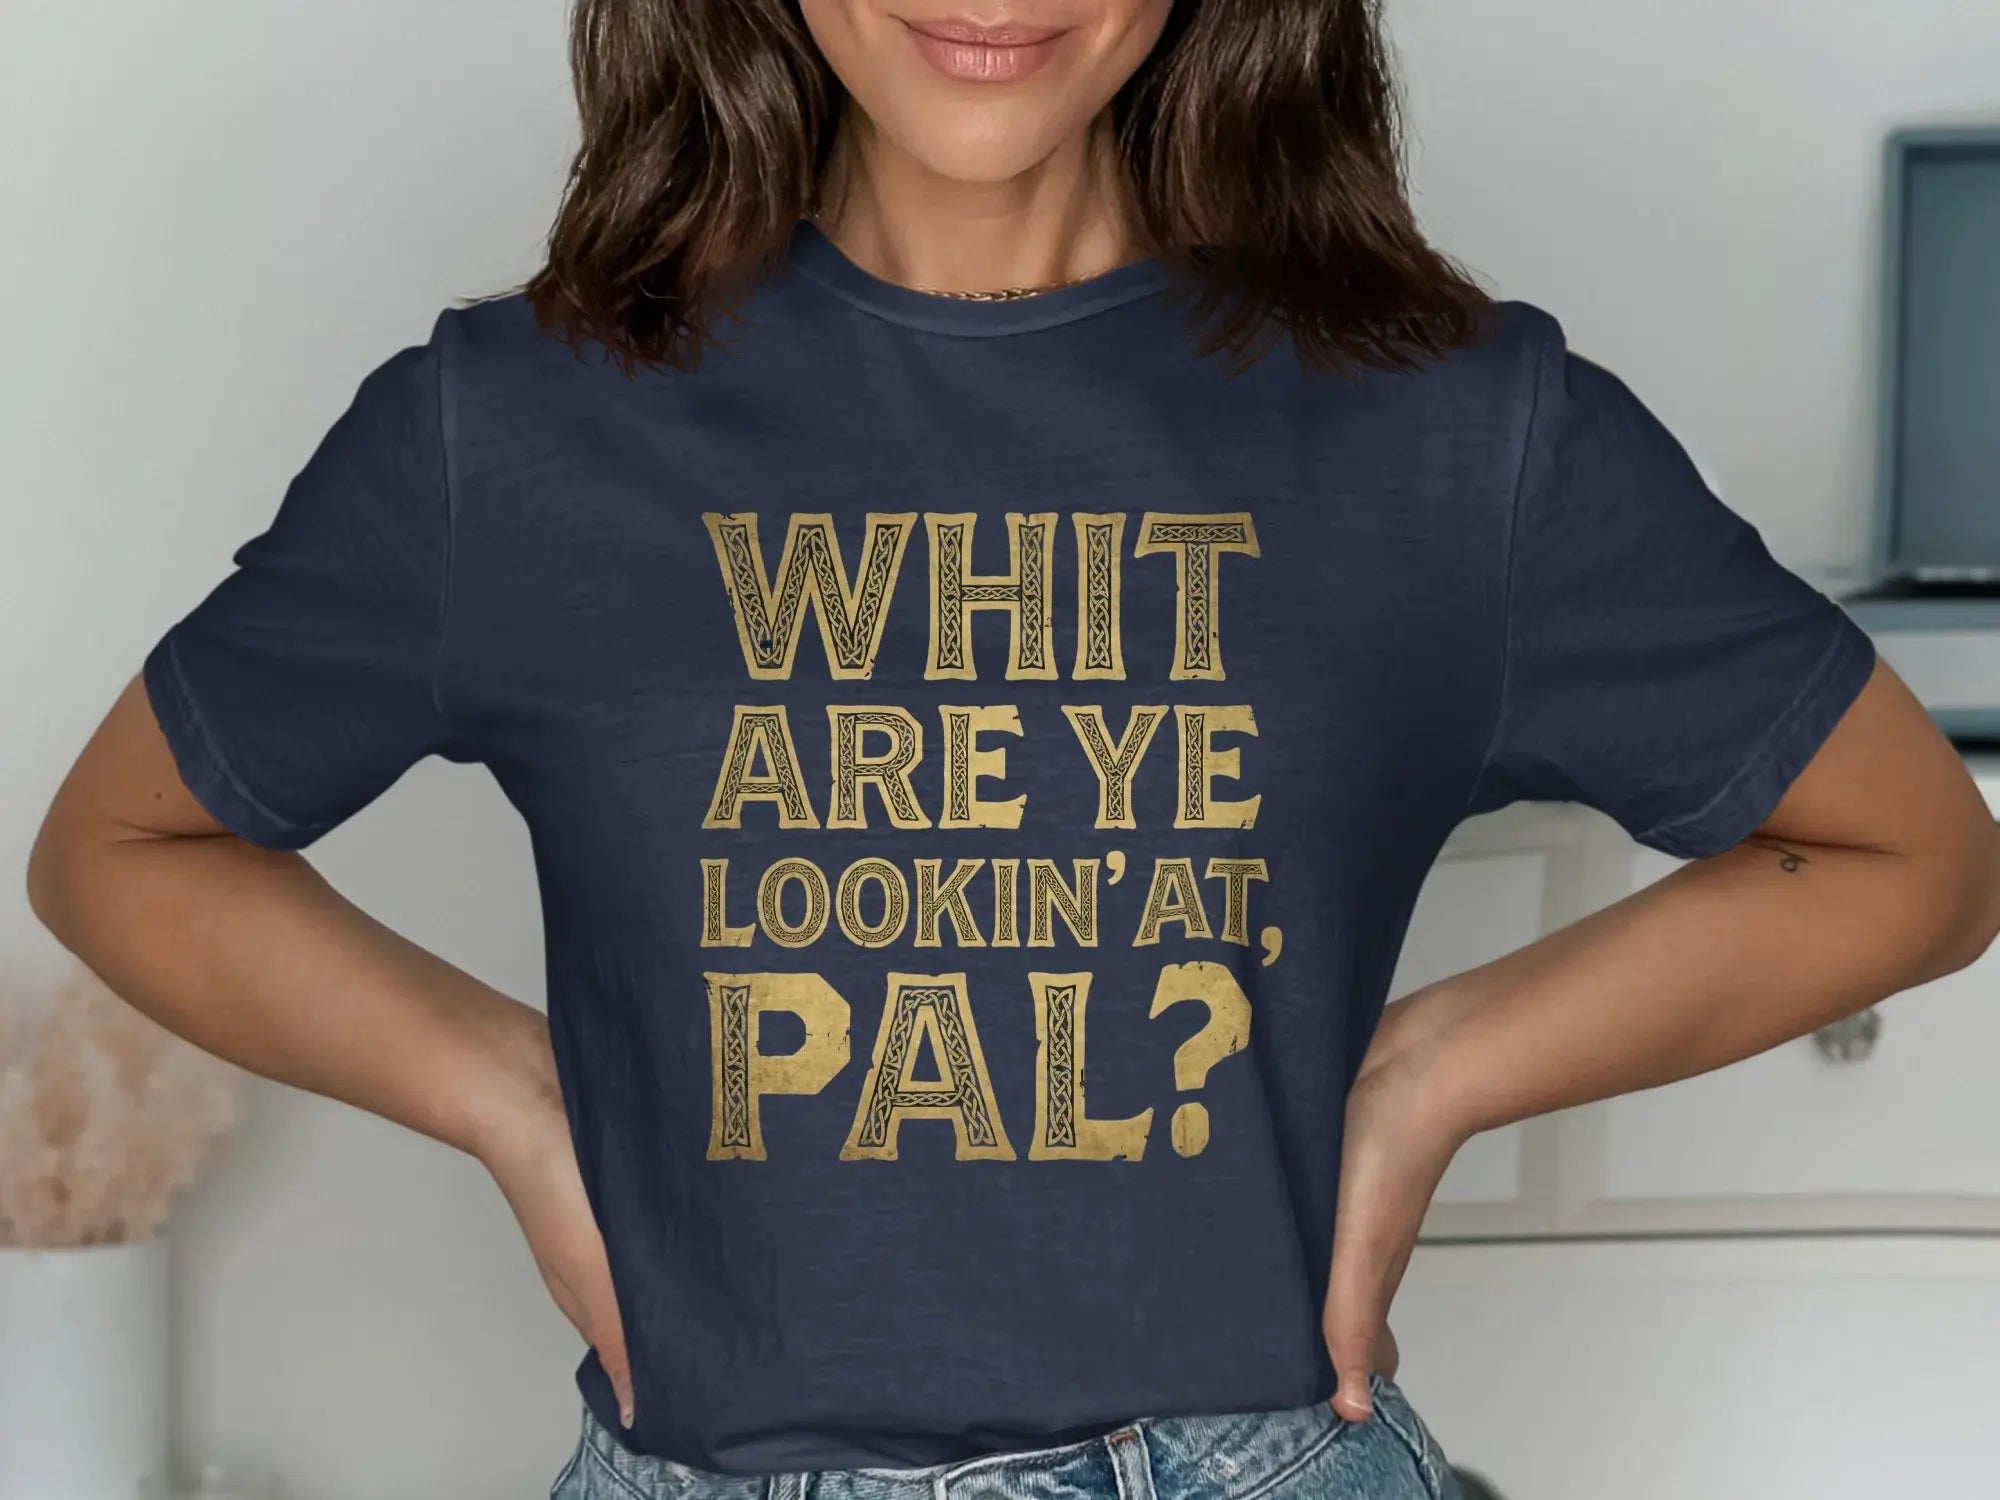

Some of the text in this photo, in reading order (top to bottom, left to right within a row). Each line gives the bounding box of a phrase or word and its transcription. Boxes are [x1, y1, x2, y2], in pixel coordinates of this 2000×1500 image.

[702, 511, 1261, 681] WHIT
[702, 704, 1262, 830] ARE YE
[700, 850, 1284, 967] LOOKIN' AT,
[703, 960, 1254, 1163] PAL?
